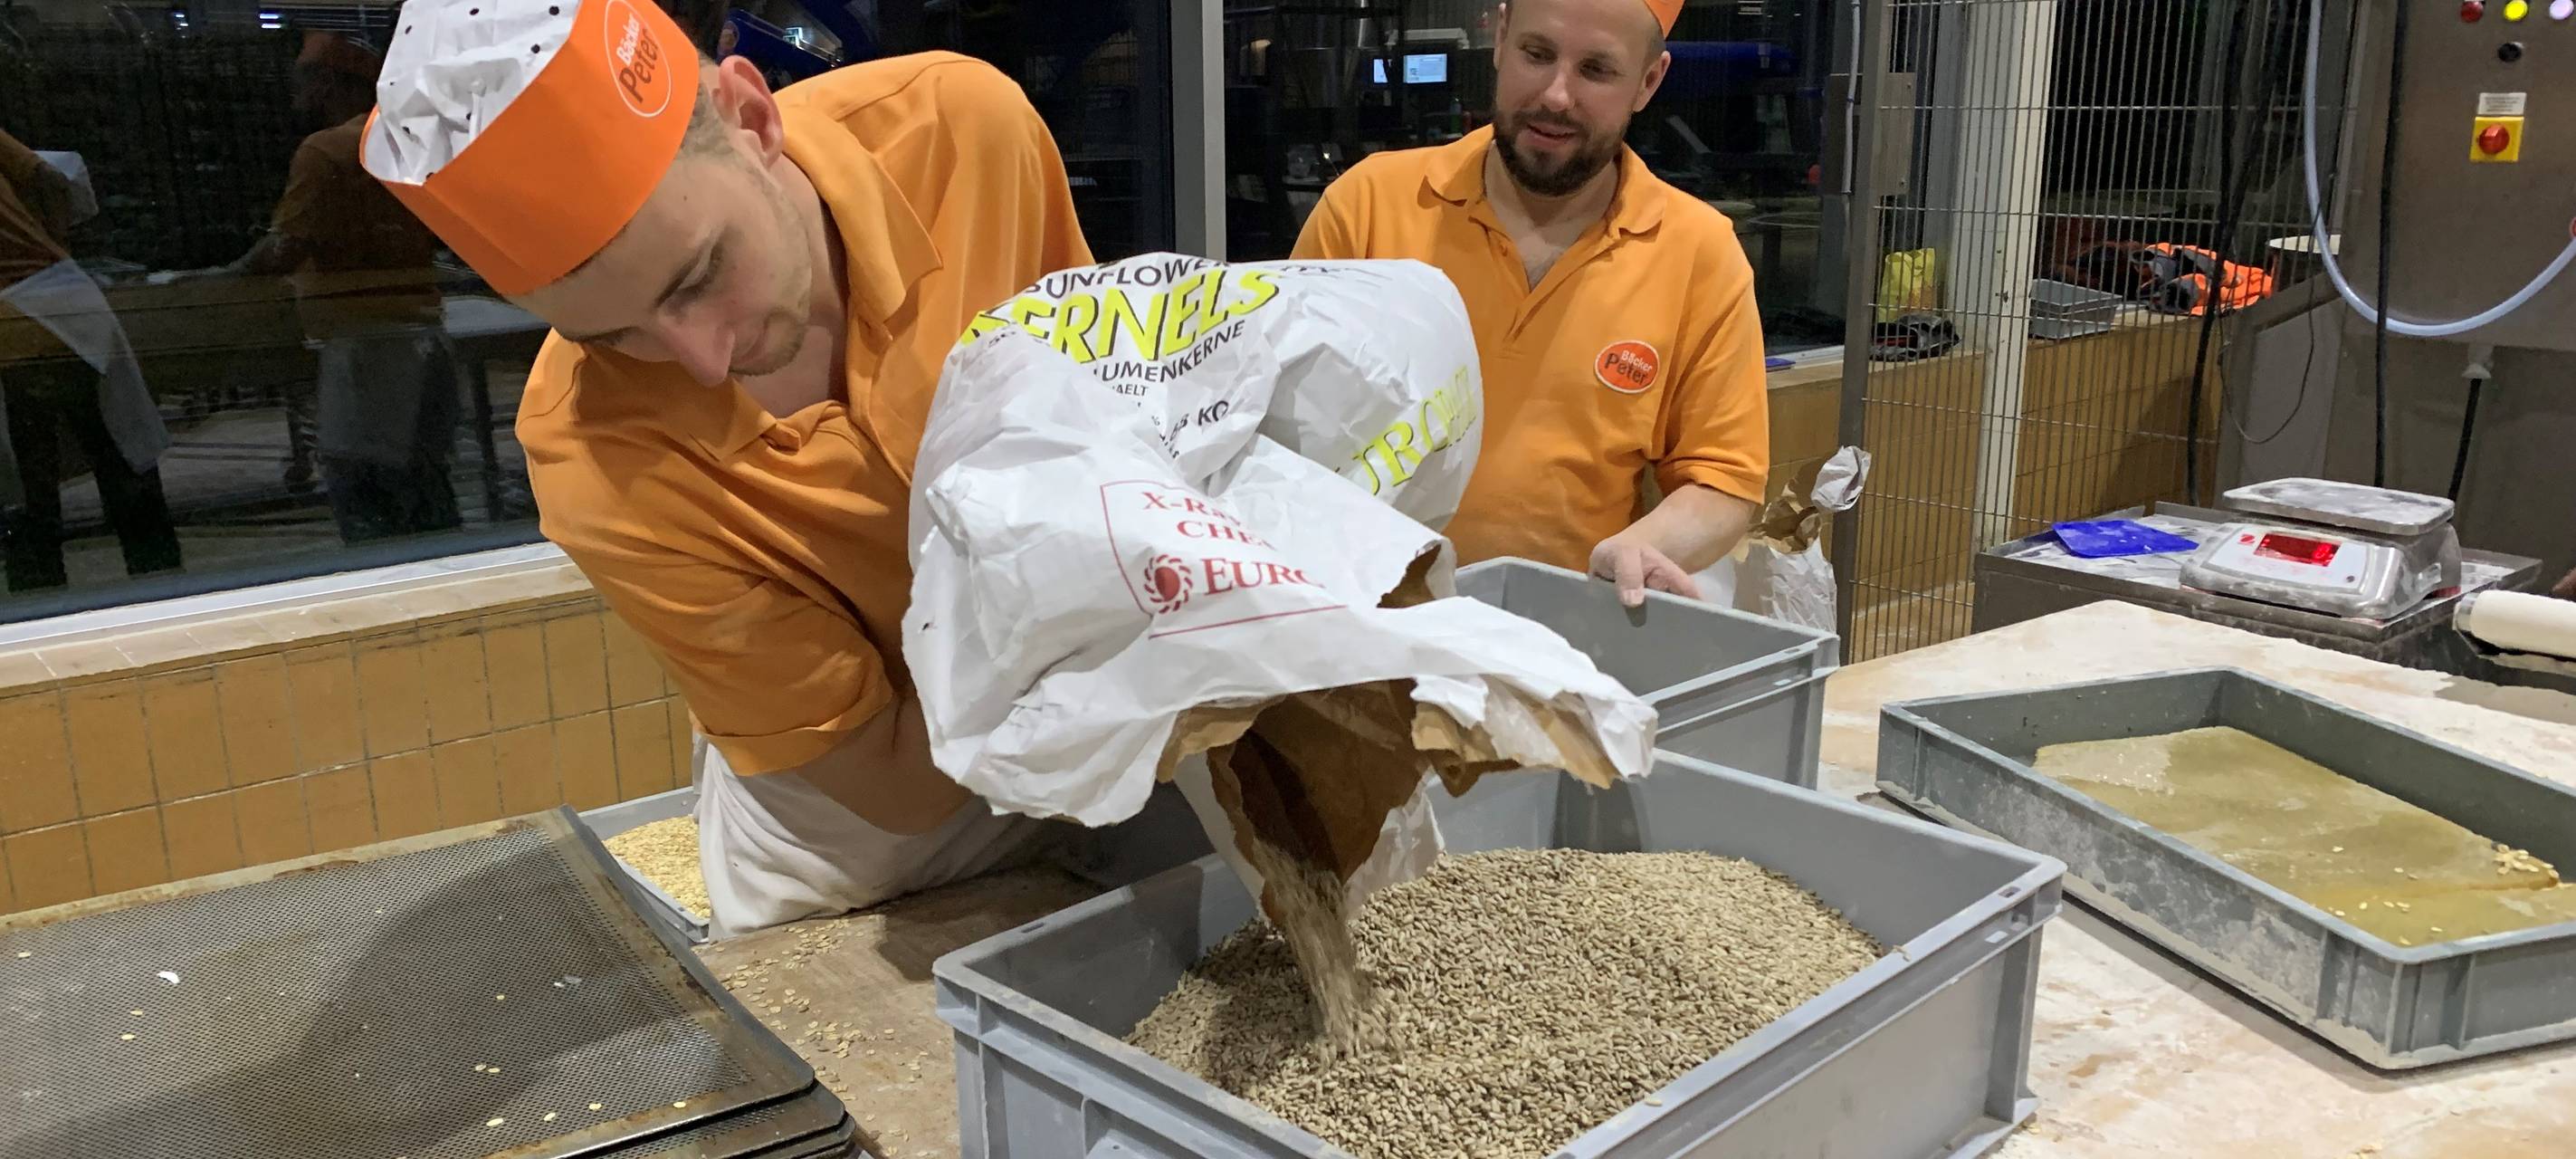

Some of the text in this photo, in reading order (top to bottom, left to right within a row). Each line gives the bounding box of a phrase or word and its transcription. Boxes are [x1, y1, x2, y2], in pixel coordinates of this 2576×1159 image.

[619, 28, 658, 103] Peter
[1093, 320, 1245, 382] UMENKERNE
[1605, 352, 1648, 386] Peter
